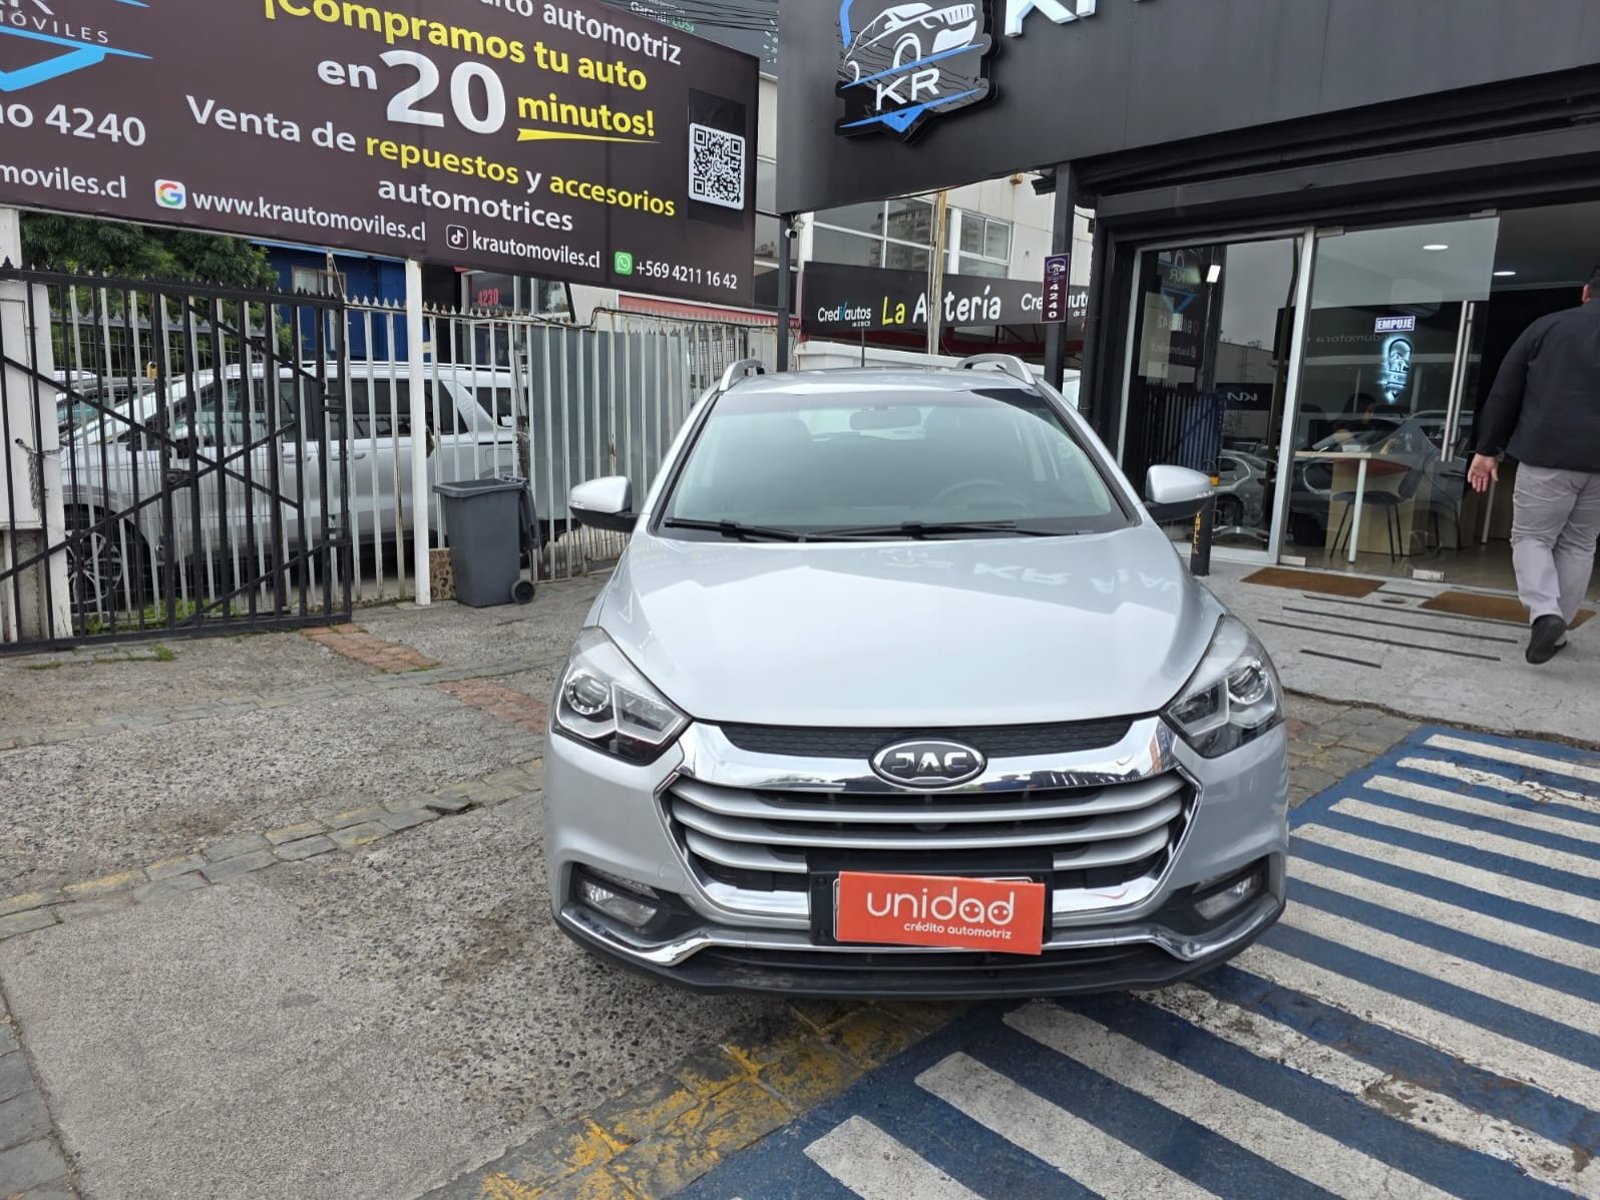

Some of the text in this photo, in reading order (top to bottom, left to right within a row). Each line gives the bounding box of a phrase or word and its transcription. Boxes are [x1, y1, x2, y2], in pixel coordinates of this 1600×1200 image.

[0, 9, 109, 44] ÓVILES
[543, 3, 682, 66] automotriz
[534, 41, 569, 75] tu
[578, 57, 648, 91] auto
[317, 50, 656, 137] en 20 minutos!
[875, 68, 940, 111] KR
[0, 103, 147, 147] o 4240
[186, 95, 676, 217] Venta de repuestos y accesorios
[192, 192, 427, 242] www.krautomoviles.cl
[378, 180, 574, 233] automotrices
[472, 235, 601, 270] krautomoviles.cl
[636, 261, 738, 290] +569 4211 16 42
[882, 284, 1001, 325] La Atería
[1377, 318, 1413, 330] EMPUJE
[891, 752, 968, 773] JAC
[866, 886, 1015, 926] unidad
[903, 921, 1012, 940] crédito automotriz
